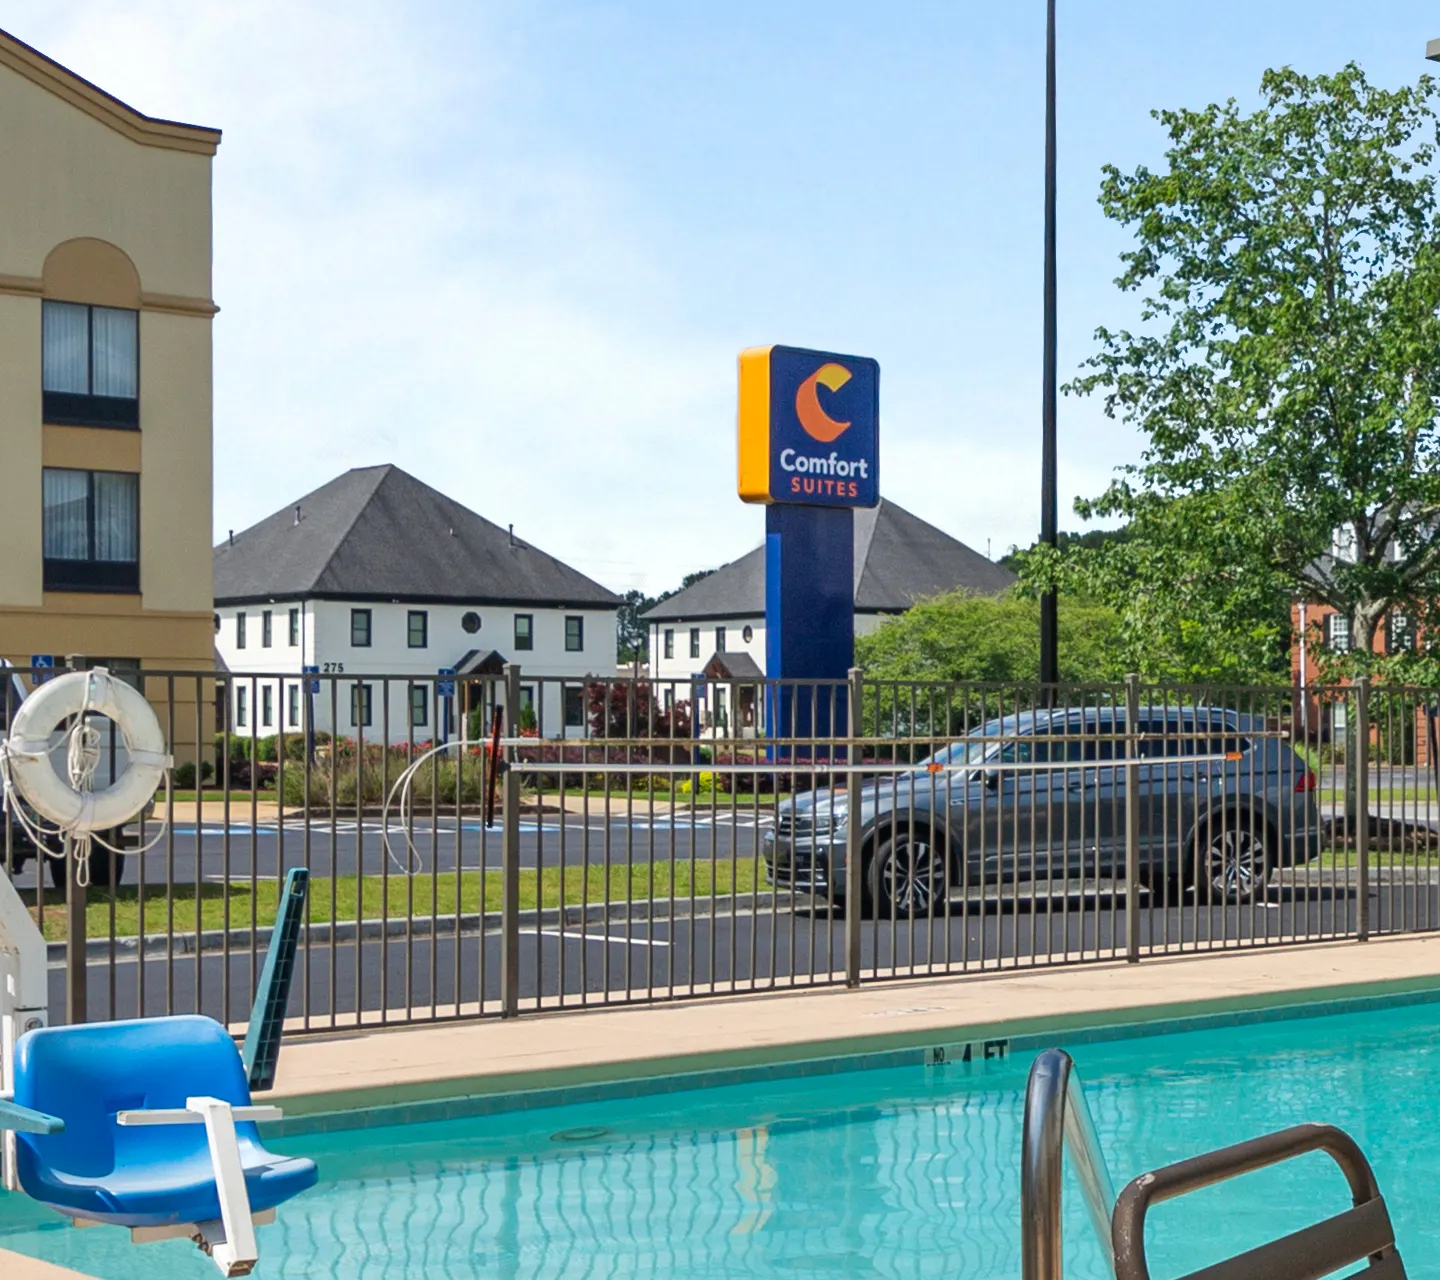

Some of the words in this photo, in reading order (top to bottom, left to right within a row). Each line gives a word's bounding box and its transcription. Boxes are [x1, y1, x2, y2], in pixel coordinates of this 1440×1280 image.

[780, 448, 868, 479] Comfort
[791, 476, 858, 497] SUITES
[323, 662, 344, 673] 275
[933, 1046, 945, 1063] NO
[984, 1039, 1008, 1060] FT
